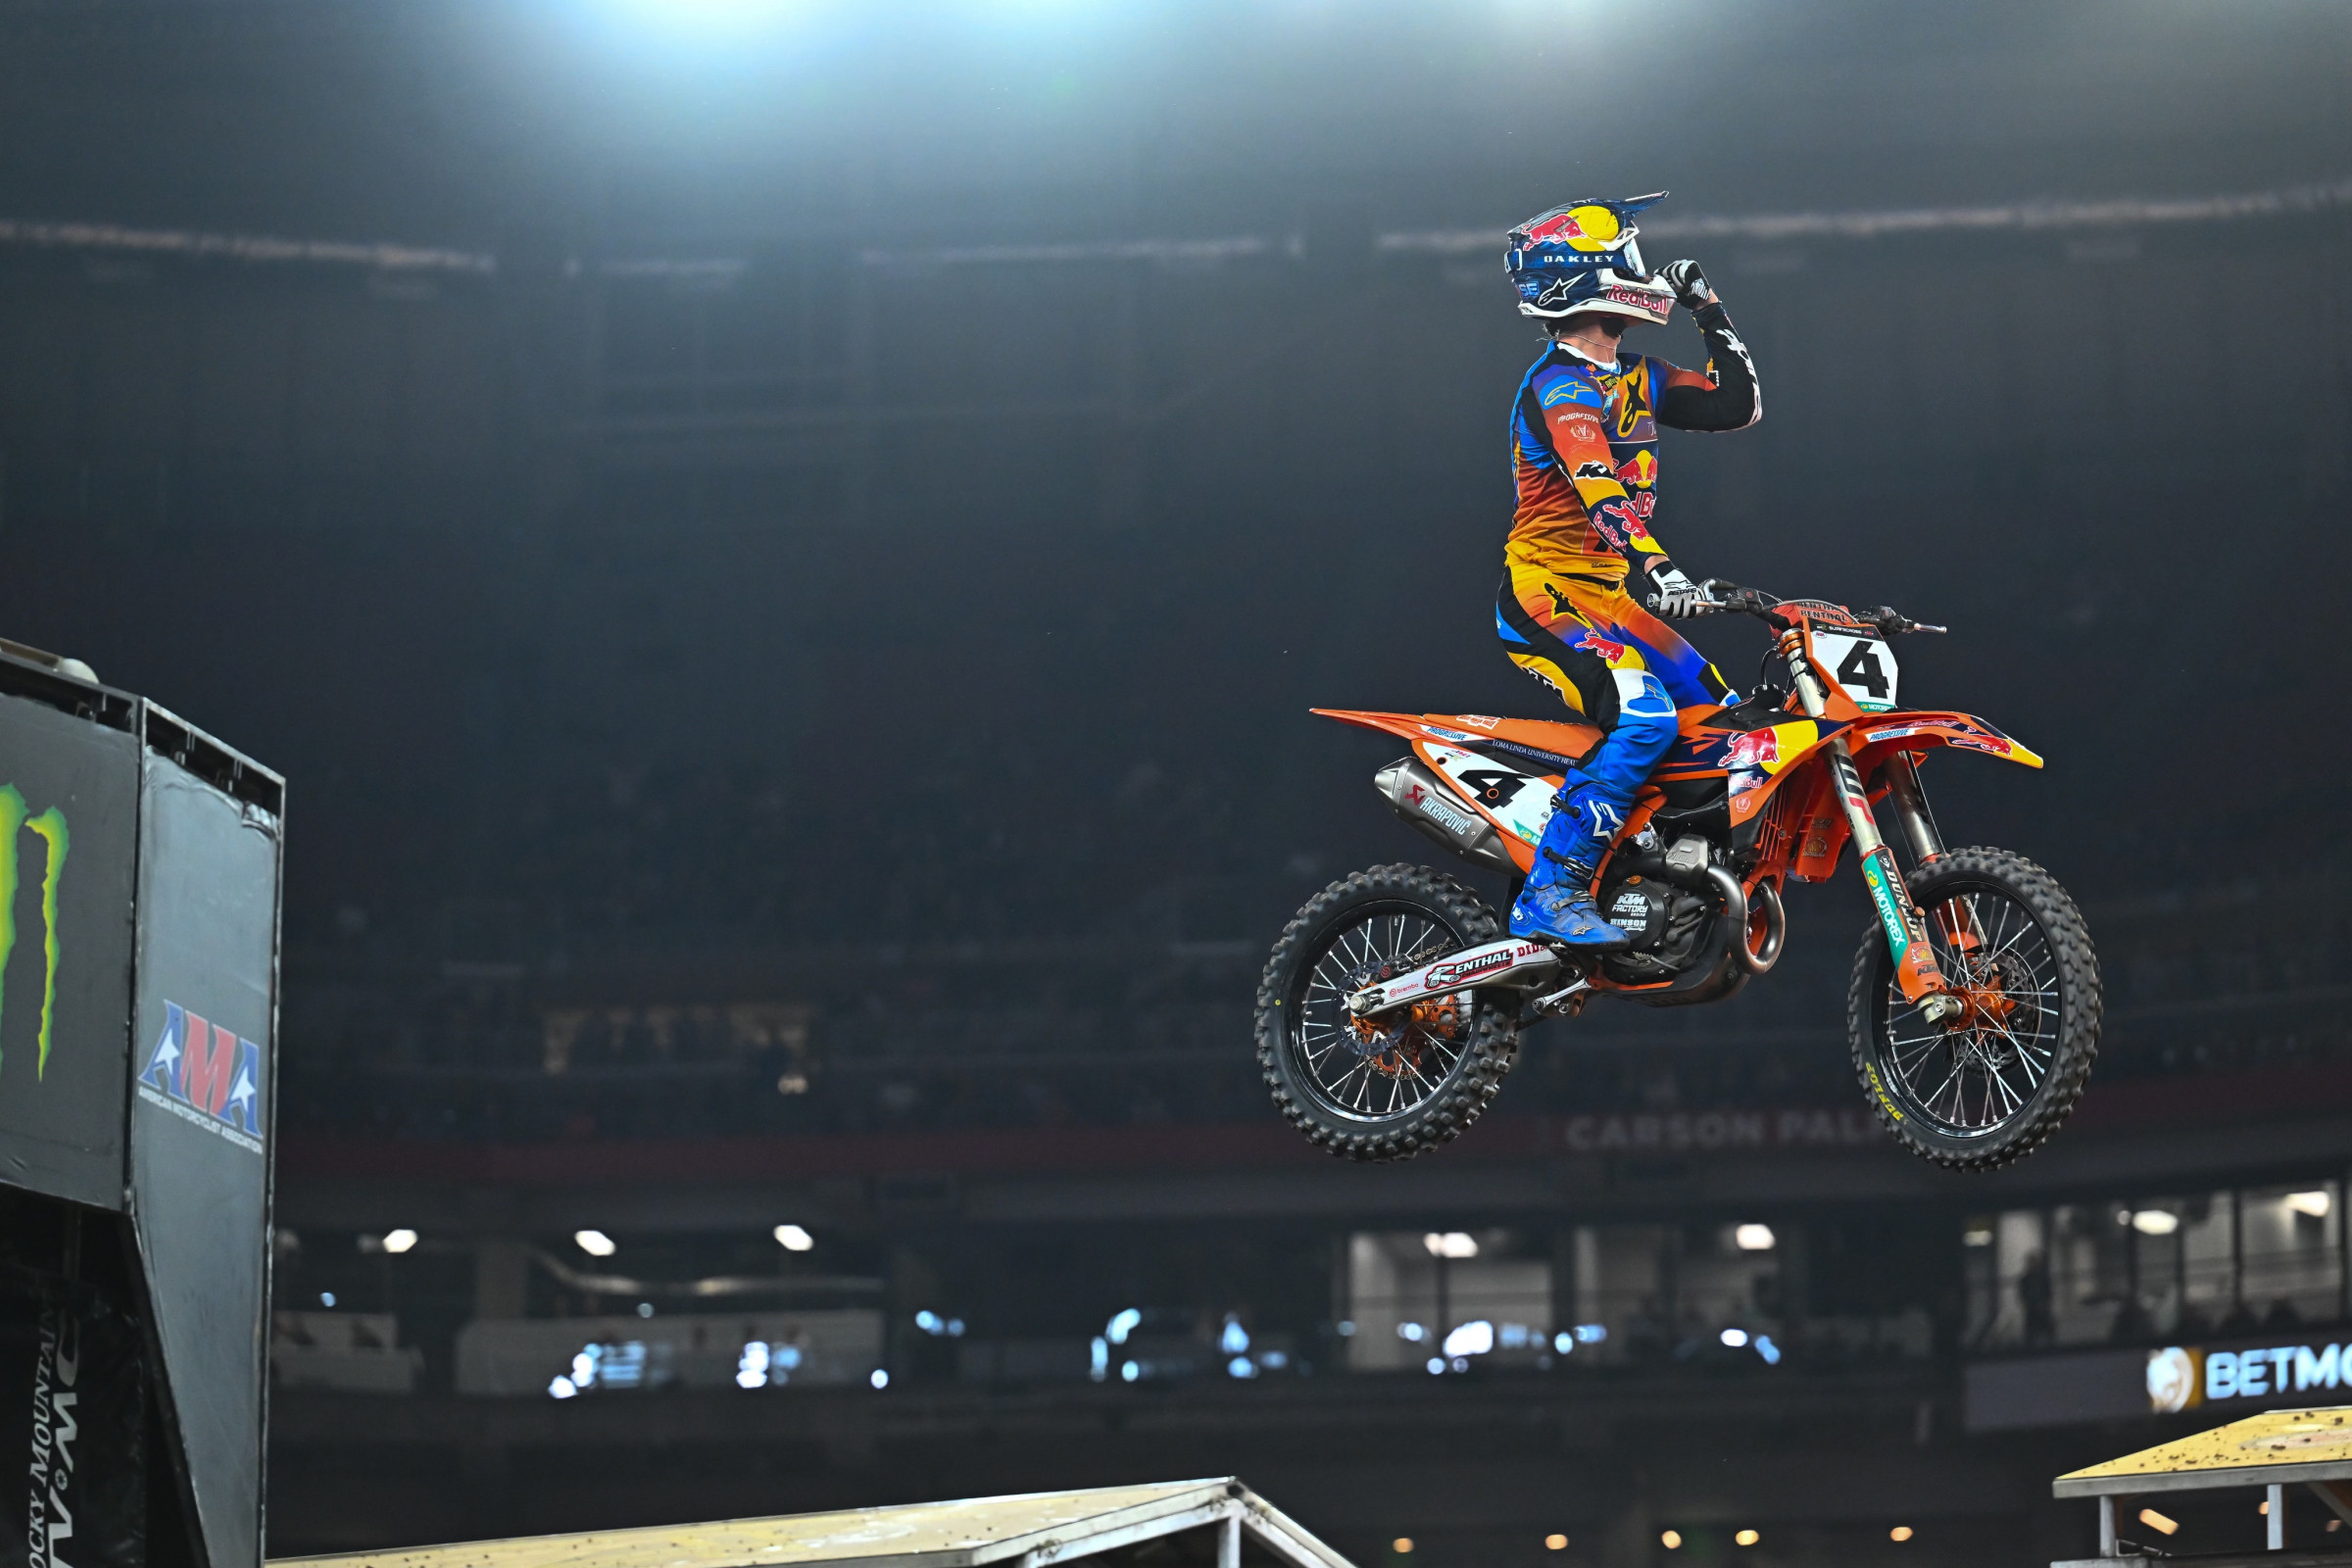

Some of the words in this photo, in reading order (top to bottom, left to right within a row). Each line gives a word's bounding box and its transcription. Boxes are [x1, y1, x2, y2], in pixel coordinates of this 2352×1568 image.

[1606, 284, 1641, 306] Red
[1593, 512, 1612, 537] Red
[1800, 610, 1848, 621] RENTHAL
[1837, 640, 1889, 699] 4
[1427, 726, 1467, 741] PROGRESSIVE
[1870, 728, 1910, 741] PROGRESSIVE
[1492, 739, 1510, 750] LOMA
[1510, 744, 1527, 755] LINDA
[1527, 748, 1561, 763] UNIVERSITY
[1457, 769, 1535, 809] 4
[1746, 776, 1763, 788] Bull
[1611, 904, 1648, 913] FACTORY
[1617, 893, 1646, 905] KTM
[1873, 886, 1906, 948] MOTOREX
[1917, 964, 1939, 977] KTM
[1396, 983, 1419, 994] brembo
[137, 998, 264, 1140] AMA
[1866, 1062, 1904, 1121] DUNLOP
[1566, 1114, 1762, 1151] CARSON
[2206, 1343, 2352, 1400] BETM
[28, 1488, 47, 1568] OCKY
[48, 1485, 74, 1568] TV
